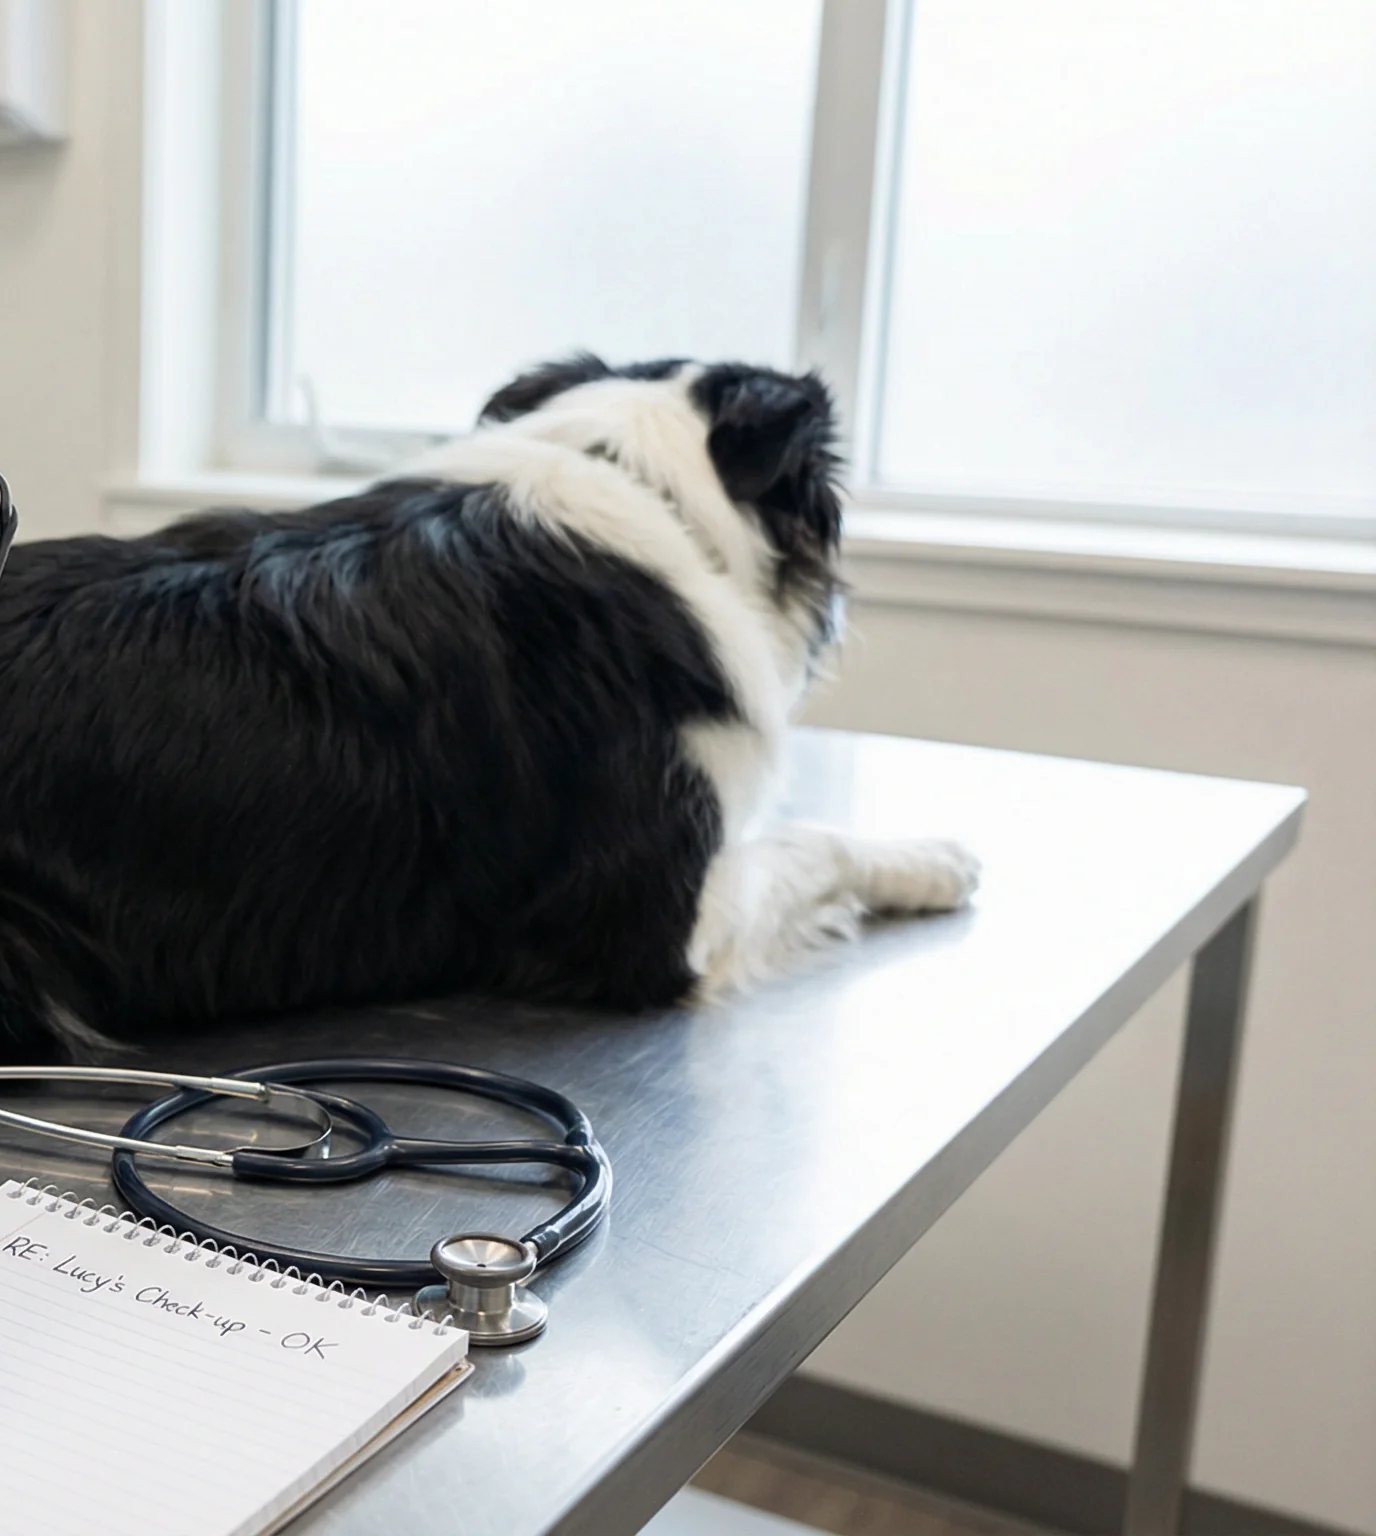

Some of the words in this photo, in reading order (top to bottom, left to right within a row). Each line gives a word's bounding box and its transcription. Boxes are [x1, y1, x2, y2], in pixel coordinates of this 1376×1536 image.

[2, 1236, 49, 1262] RE:
[53, 1255, 126, 1293] Lucy's
[134, 1286, 246, 1336] Check-up
[280, 1332, 338, 1359] OK
